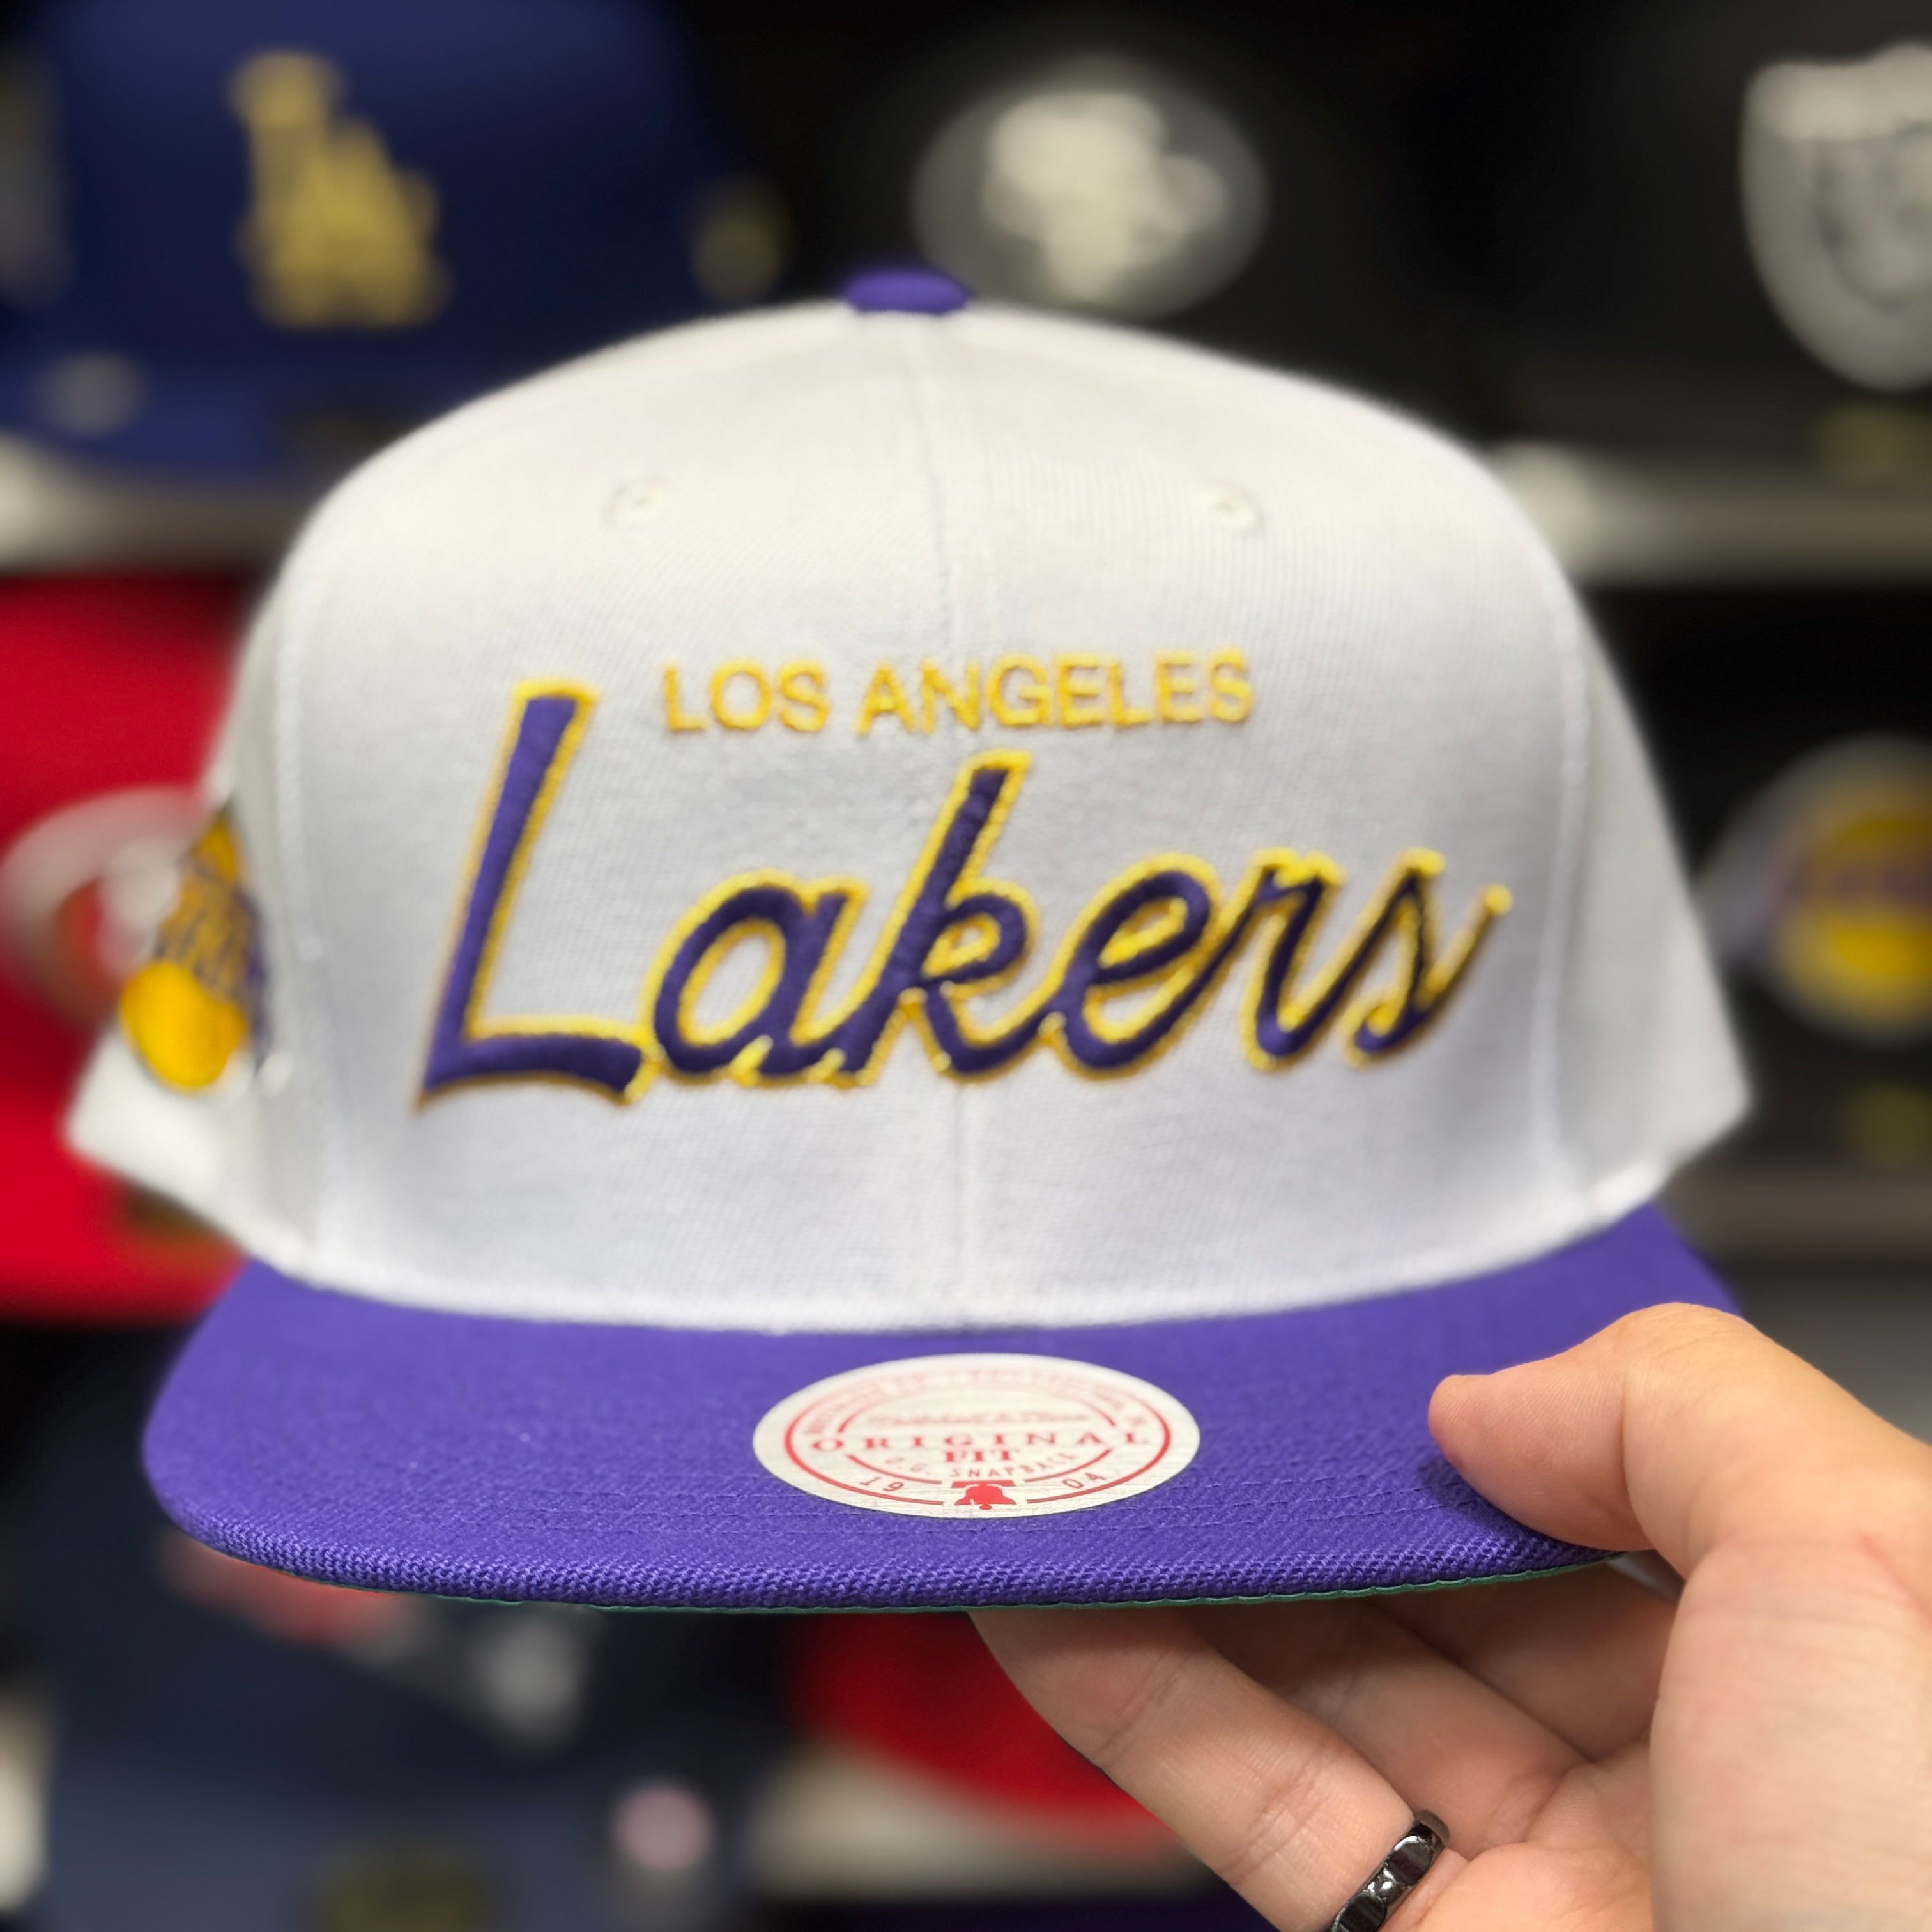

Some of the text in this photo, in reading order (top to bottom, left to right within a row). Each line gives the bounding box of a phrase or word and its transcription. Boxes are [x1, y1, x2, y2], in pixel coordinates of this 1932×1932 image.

[662, 647, 1255, 736] LOS ANGELES
[413, 677, 1512, 1113] Lakers
[810, 1430, 1148, 1452] ORIGINAL
[942, 1448, 1021, 1464] FIT
[859, 1471, 1107, 1492] 19 04
